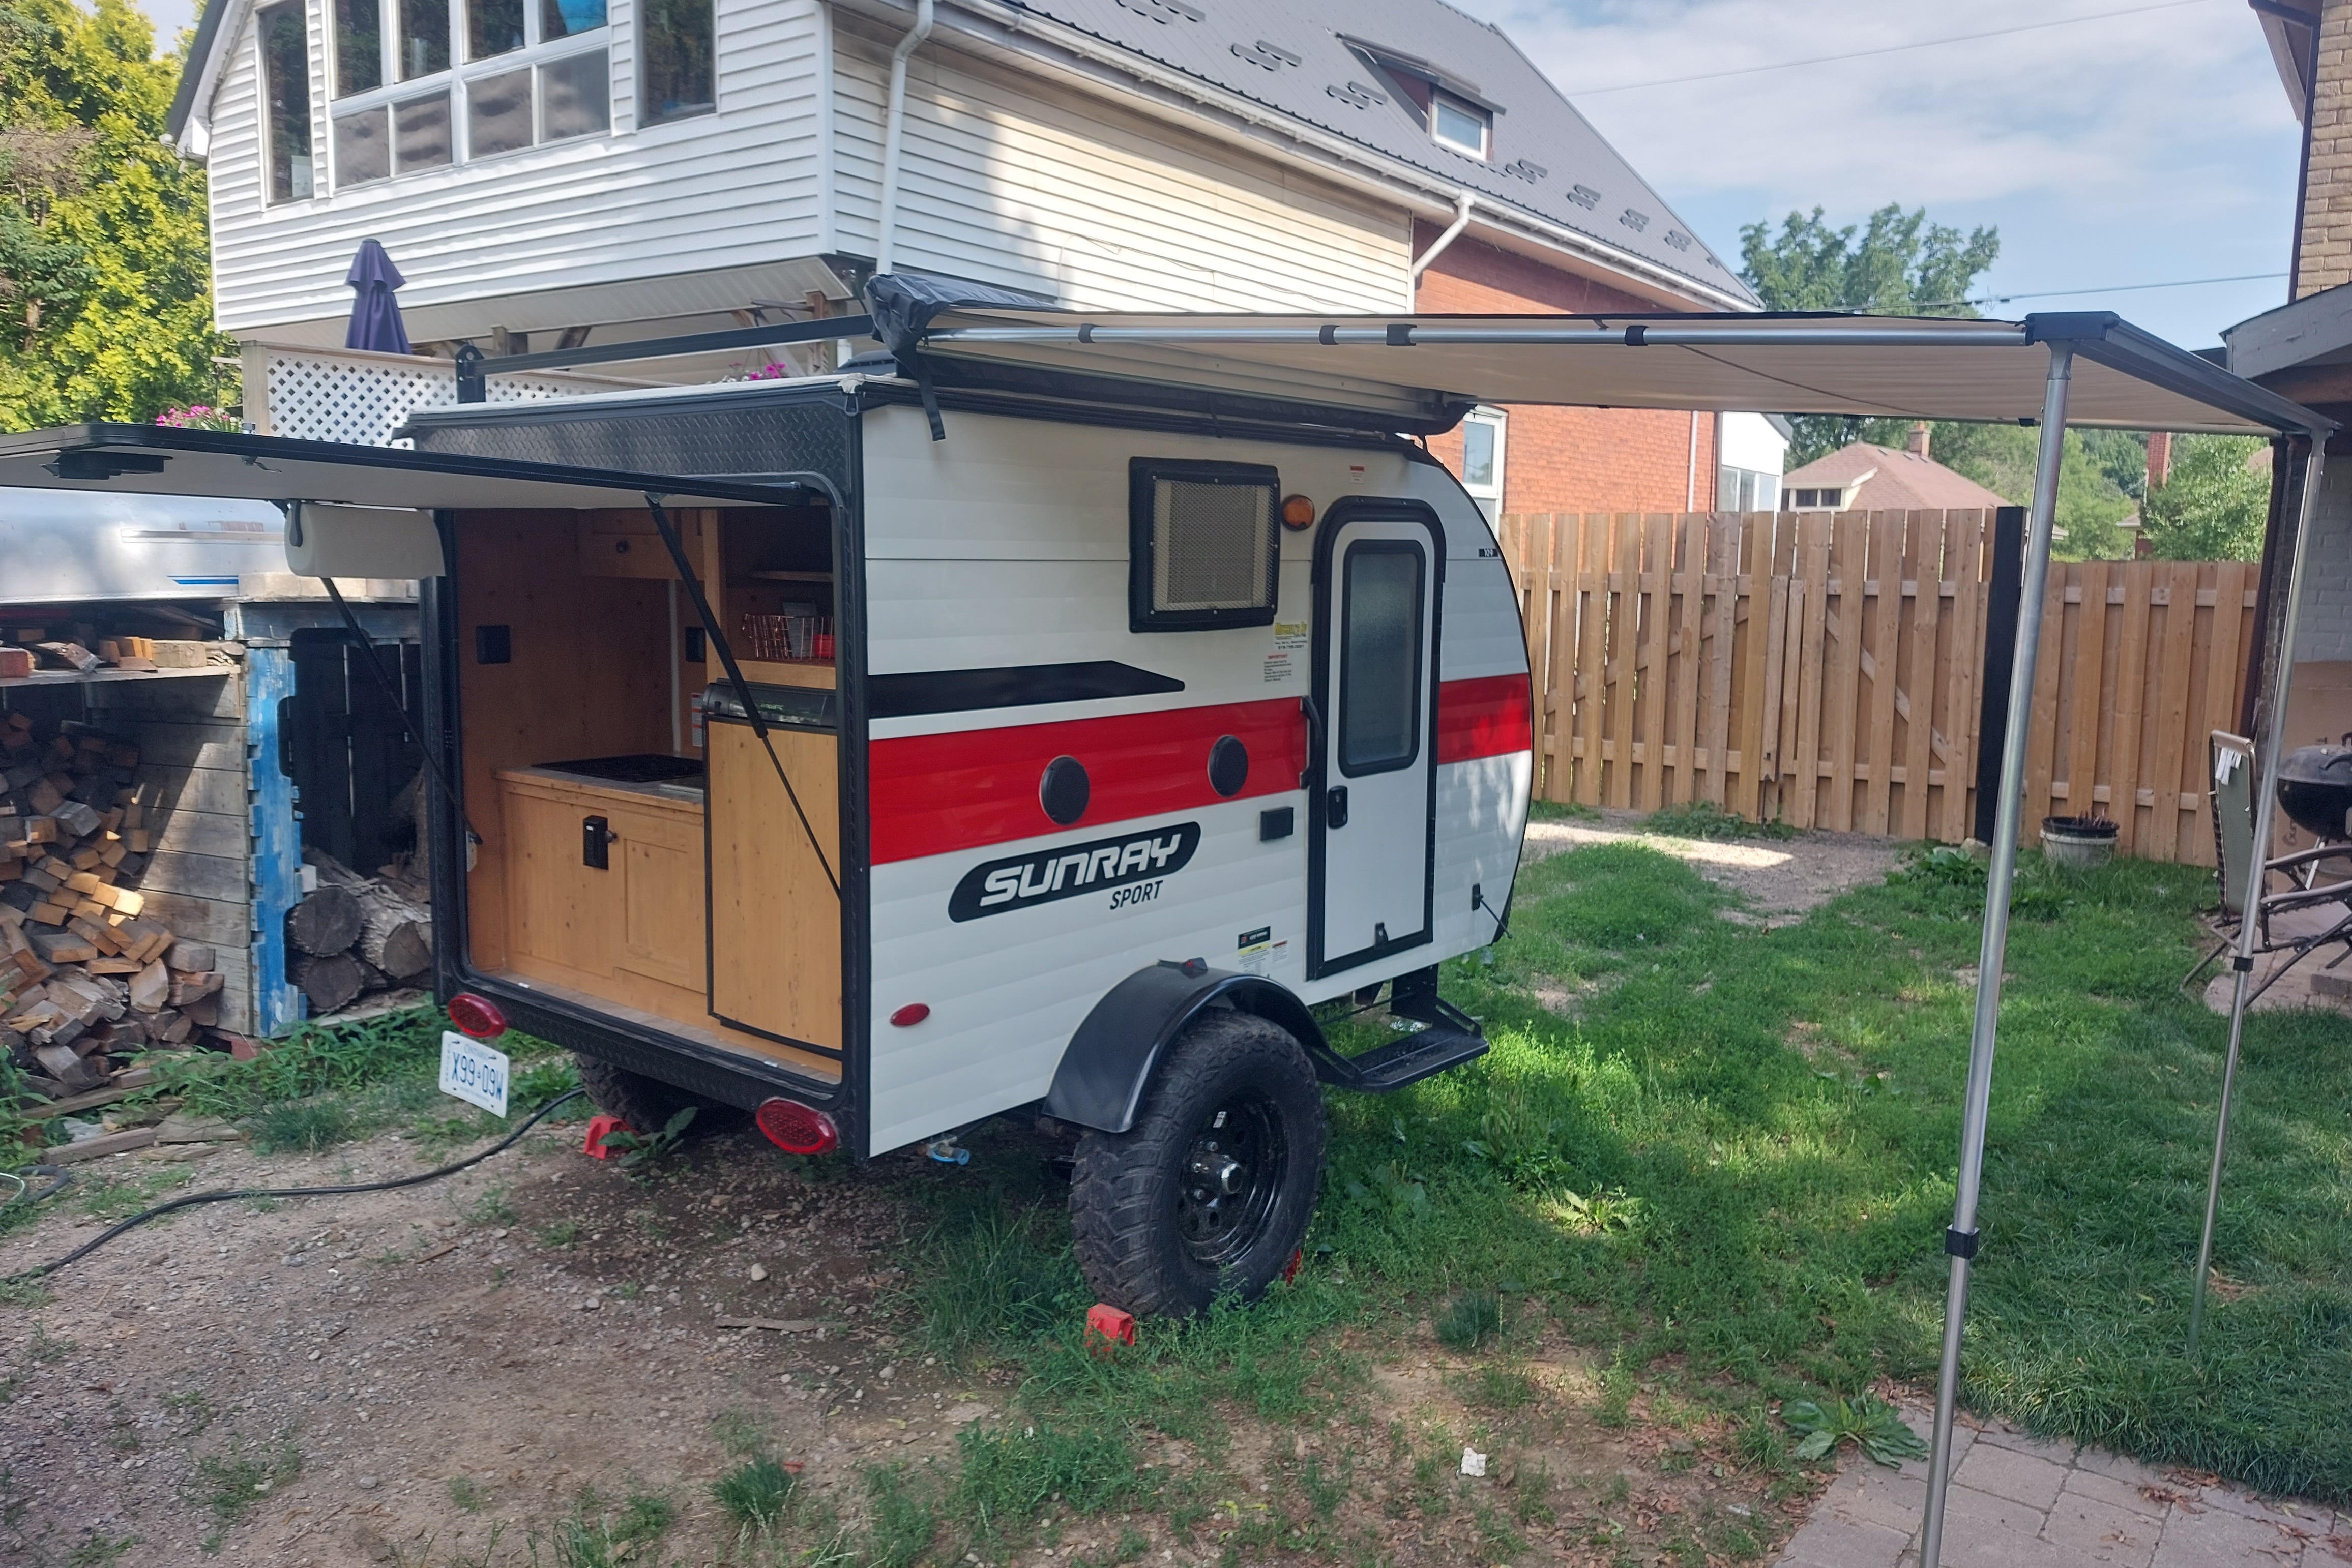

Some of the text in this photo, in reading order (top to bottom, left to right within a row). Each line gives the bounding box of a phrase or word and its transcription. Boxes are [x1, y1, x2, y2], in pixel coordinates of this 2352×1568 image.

[1484, 549, 1493, 557] 109
[980, 834, 1181, 906] SUNRAY
[1110, 880, 1163, 910] SPORT
